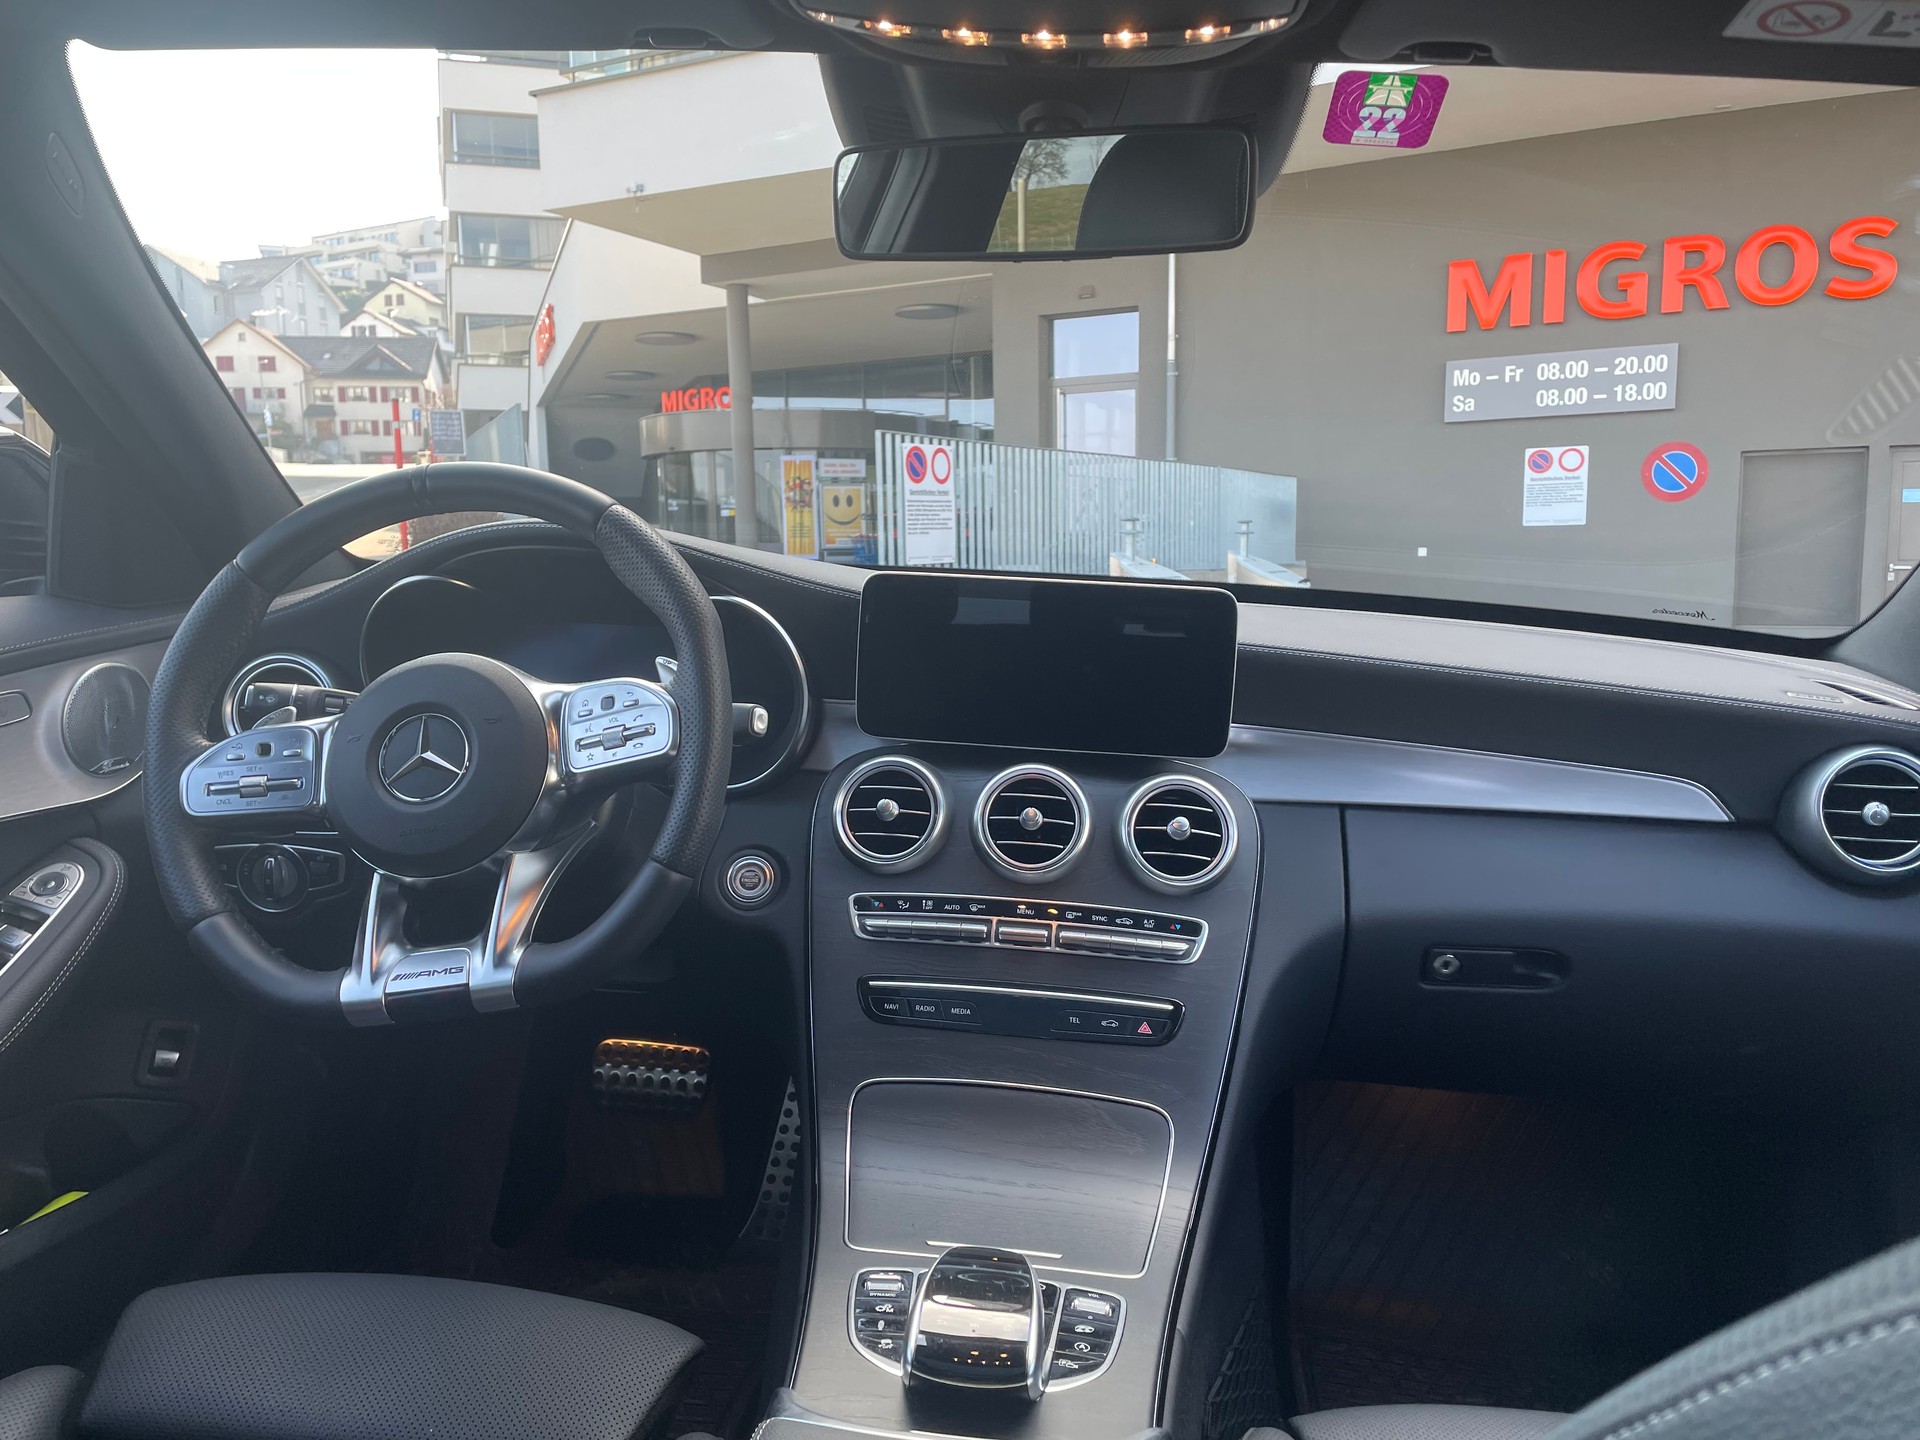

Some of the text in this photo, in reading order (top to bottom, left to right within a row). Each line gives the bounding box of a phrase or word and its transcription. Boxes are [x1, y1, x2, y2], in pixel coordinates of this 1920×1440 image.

[1354, 106, 1406, 139] 22
[1447, 215, 1899, 333] MIGROS
[1453, 369, 1480, 387] Mo
[1505, 365, 1524, 383] Fr
[1537, 360, 1589, 381] 08.00
[1614, 354, 1668, 376] 20.00
[661, 386, 732, 414] MIGRO
[1452, 395, 1475, 413] Sa
[1536, 387, 1588, 407] 08.00
[1614, 381, 1667, 402] 18.00
[1016, 908, 1035, 916] MENU
[415, 966, 464, 979] AMG
[884, 1002, 899, 1011] NAVI
[915, 1004, 935, 1013] RADIO
[951, 1007, 971, 1016] MEDIA
[1069, 1016, 1081, 1024] TEL
